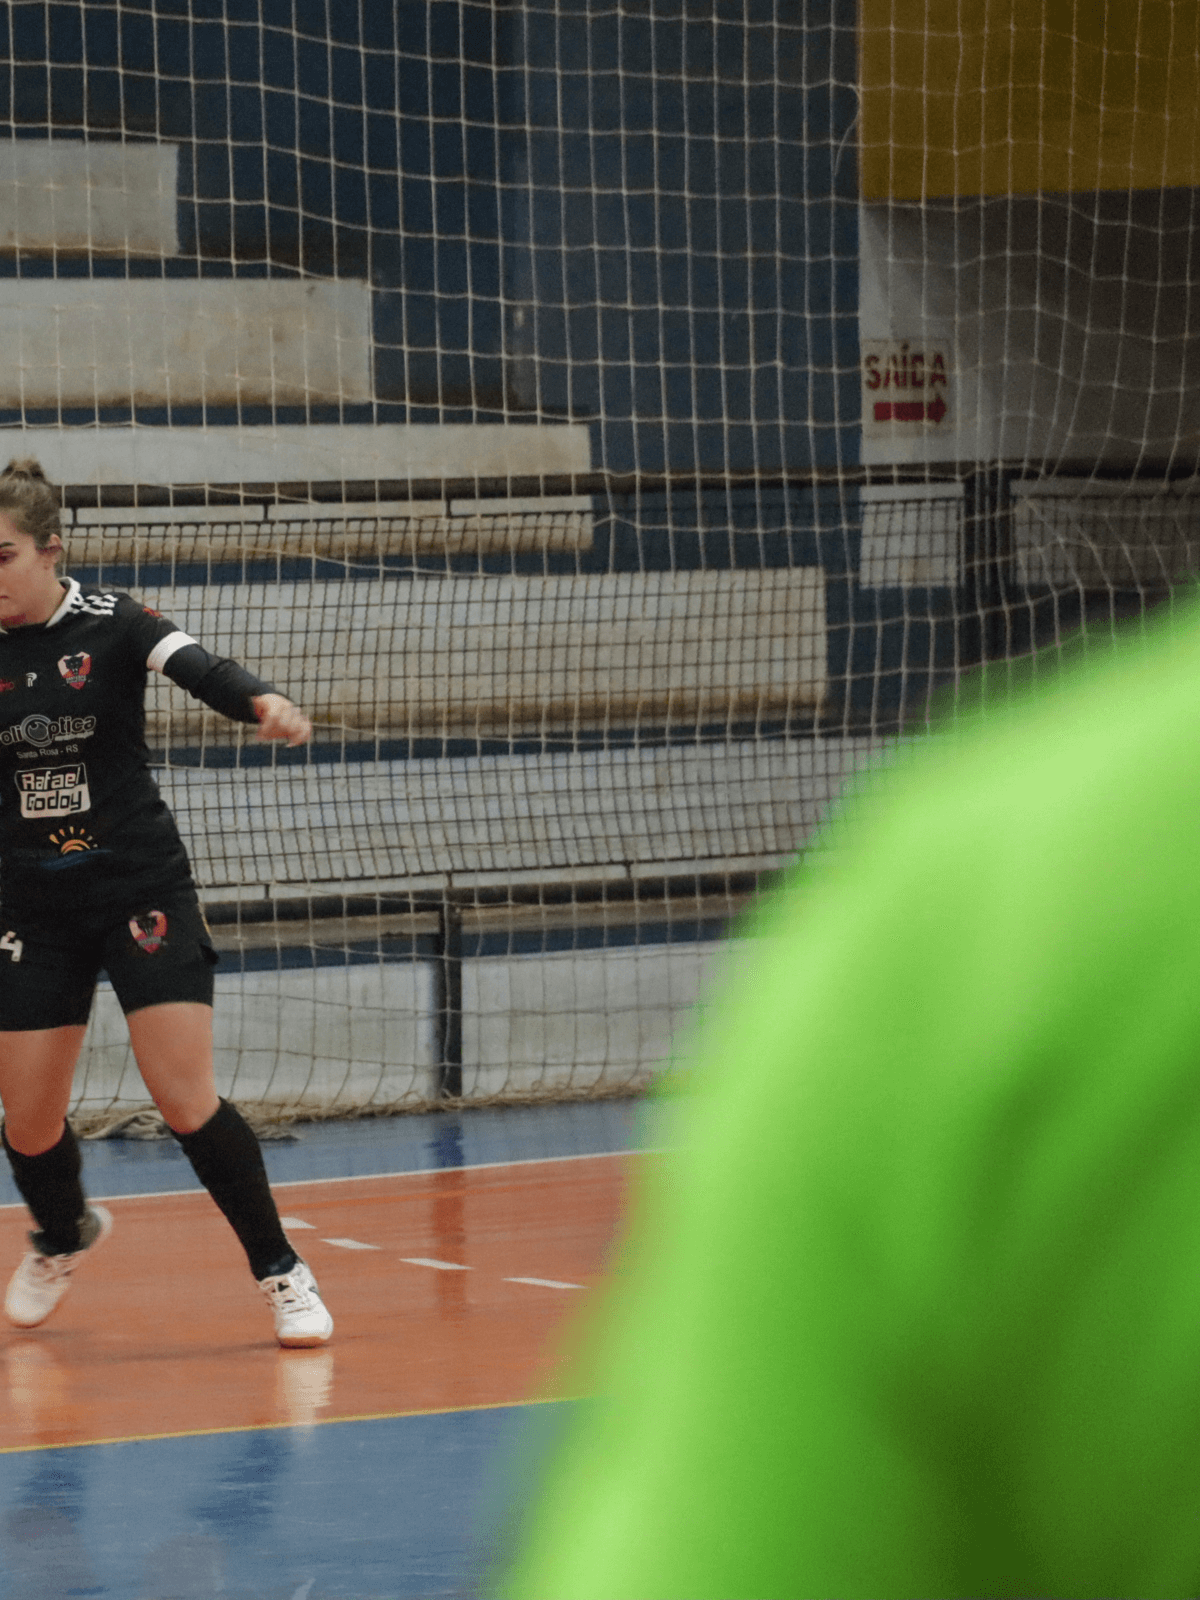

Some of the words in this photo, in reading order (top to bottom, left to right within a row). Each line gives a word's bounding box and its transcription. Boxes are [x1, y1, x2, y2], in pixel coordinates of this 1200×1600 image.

[66, 744, 79, 753] RS
[21, 767, 81, 791] Rafael
[26, 791, 82, 812] Godoy
